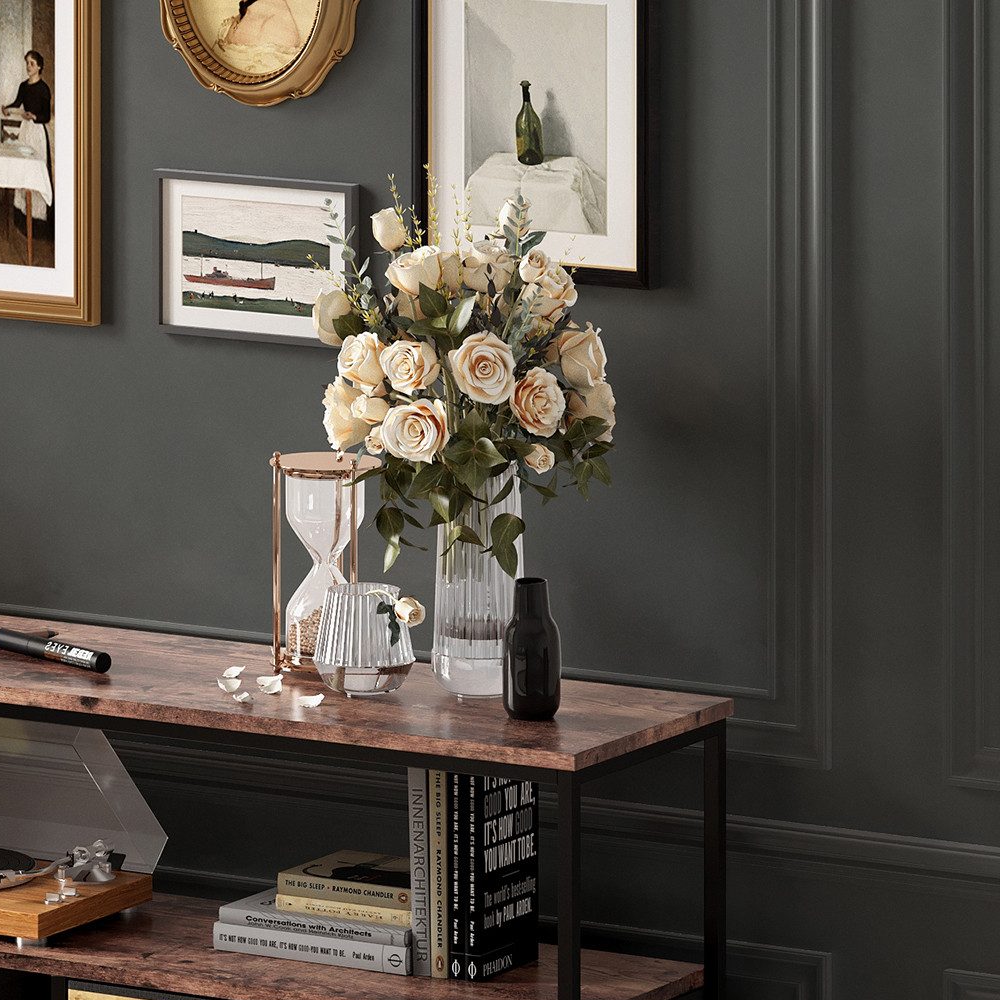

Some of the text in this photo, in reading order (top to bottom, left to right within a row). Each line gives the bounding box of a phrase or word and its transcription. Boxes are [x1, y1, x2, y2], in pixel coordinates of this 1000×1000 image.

[484, 790, 502, 819] GOOD
[504, 784, 518, 811] YOU
[484, 806, 533, 847] IT'S HOW GOOD
[484, 846, 498, 873] YOU
[498, 840, 517, 868] WANT
[517, 836, 526, 861] TO
[285, 879, 394, 900] THE BIG SLEEP RAYMOND CHANDLER
[412, 788, 428, 962] INNENARCHITEKTUR
[245, 915, 372, 938] Conversations with Architects
[219, 933, 228, 942] IT'S
[228, 935, 237, 943] NOT
[237, 936, 247, 944] HOW
[248, 937, 258, 946] GOOD
[259, 939, 268, 947] YOU
[268, 940, 279, 949] ARE,
[279, 941, 288, 950] IT'S
[288, 942, 297, 951] HOW
[310, 945, 319, 954] YOU
[319, 947, 332, 955] WANT
[332, 948, 339, 957] TO
[352, 951, 362, 960] Paul
[362, 952, 375, 962] Arden
[482, 952, 513, 977] PHAIDON
